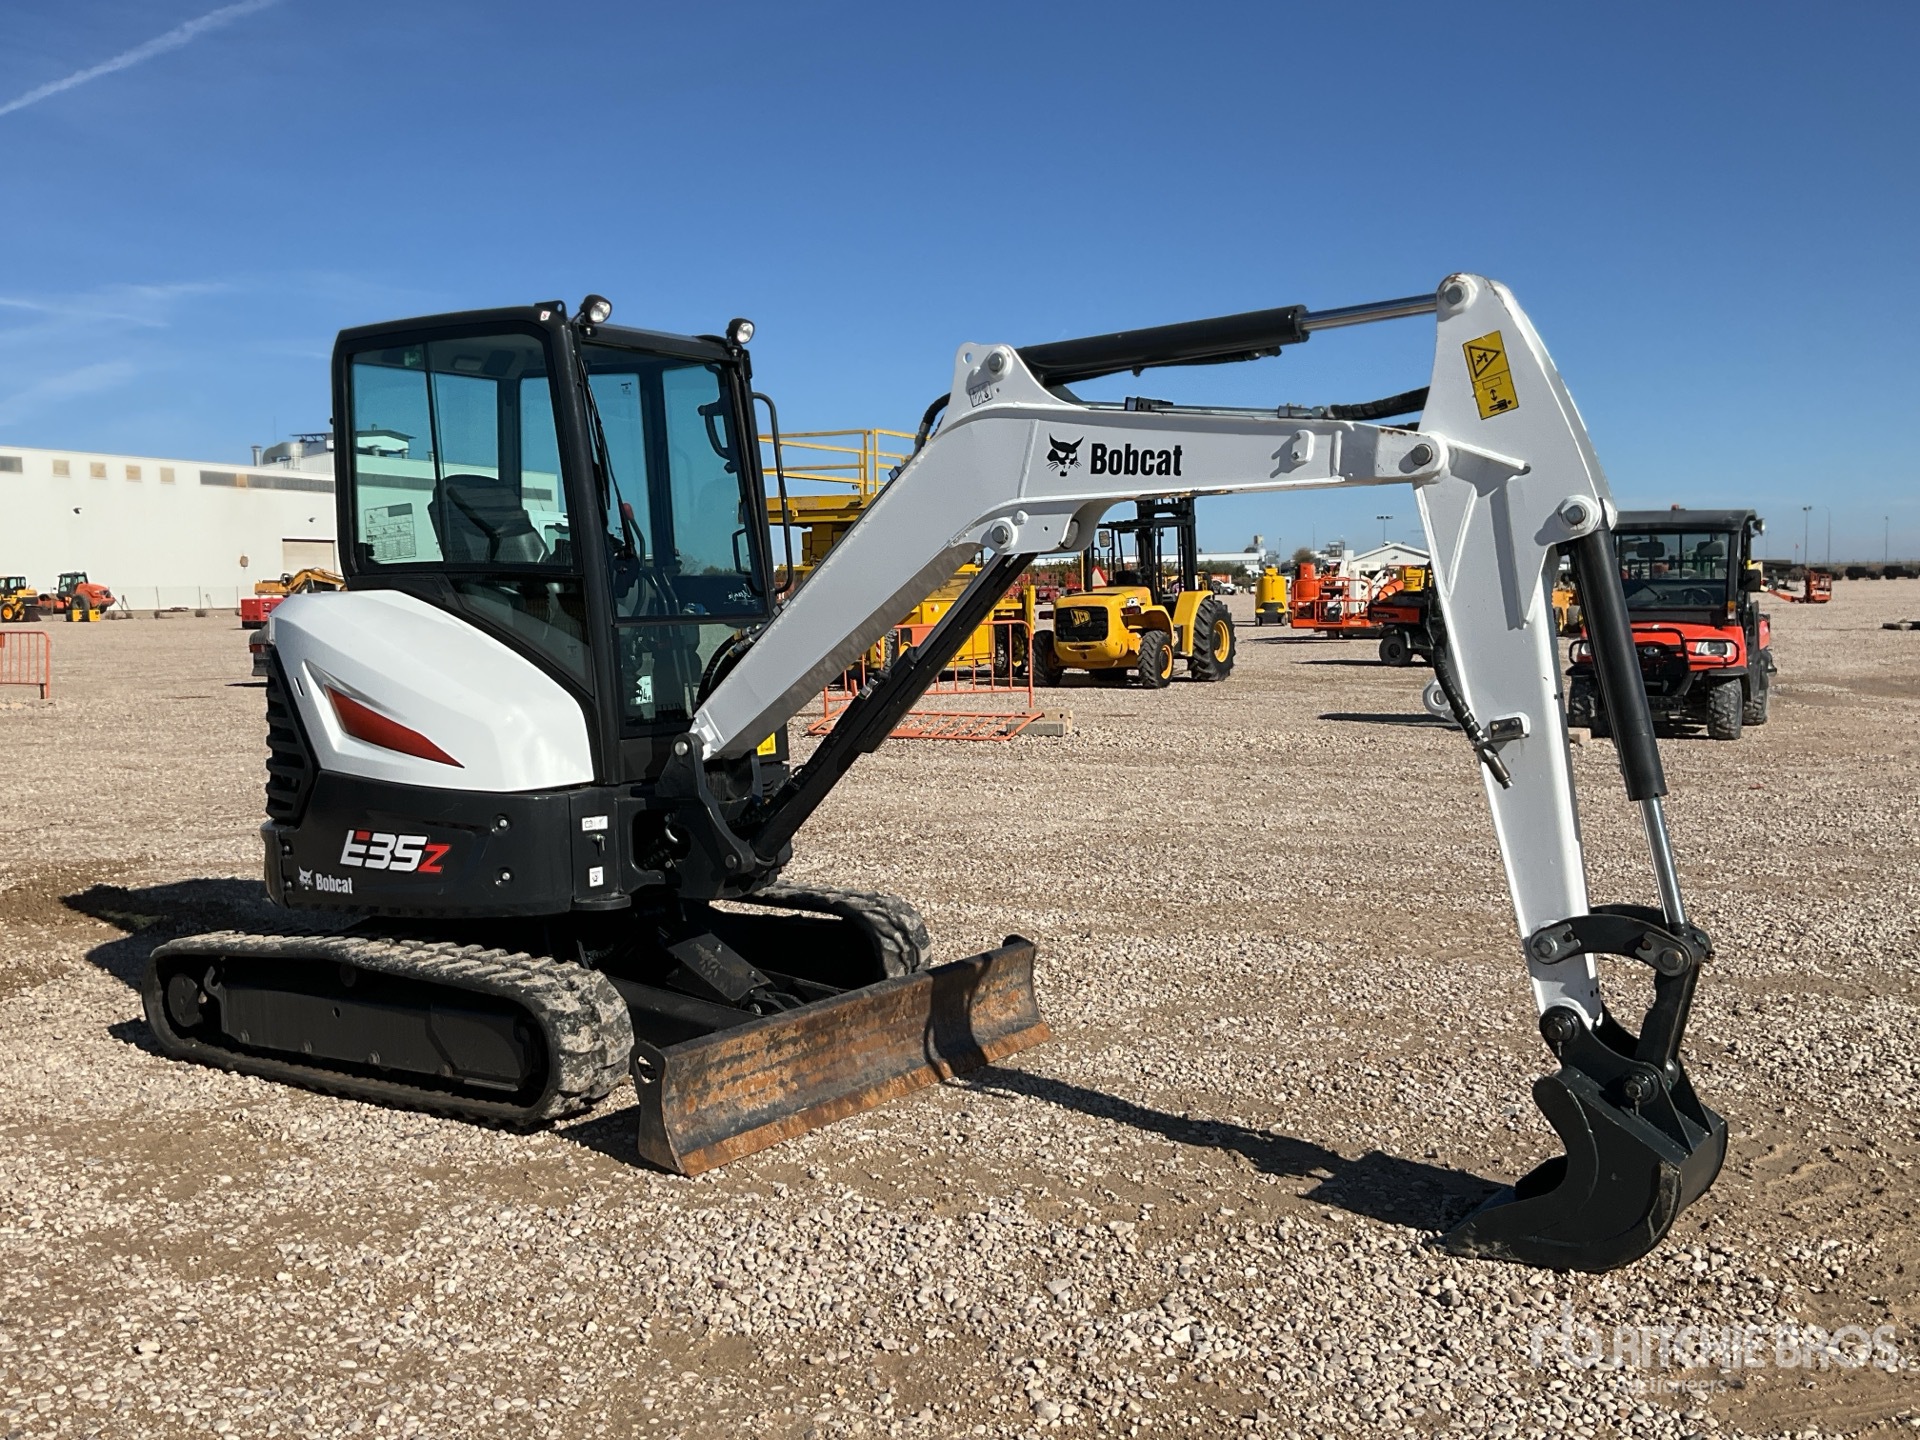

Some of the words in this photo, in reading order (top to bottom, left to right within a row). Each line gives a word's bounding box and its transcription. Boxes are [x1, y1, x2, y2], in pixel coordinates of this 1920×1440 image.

[1090, 443, 1182, 476] Bobcat
[1072, 610, 1091, 626] JCB
[315, 872, 353, 894] Bobcat
